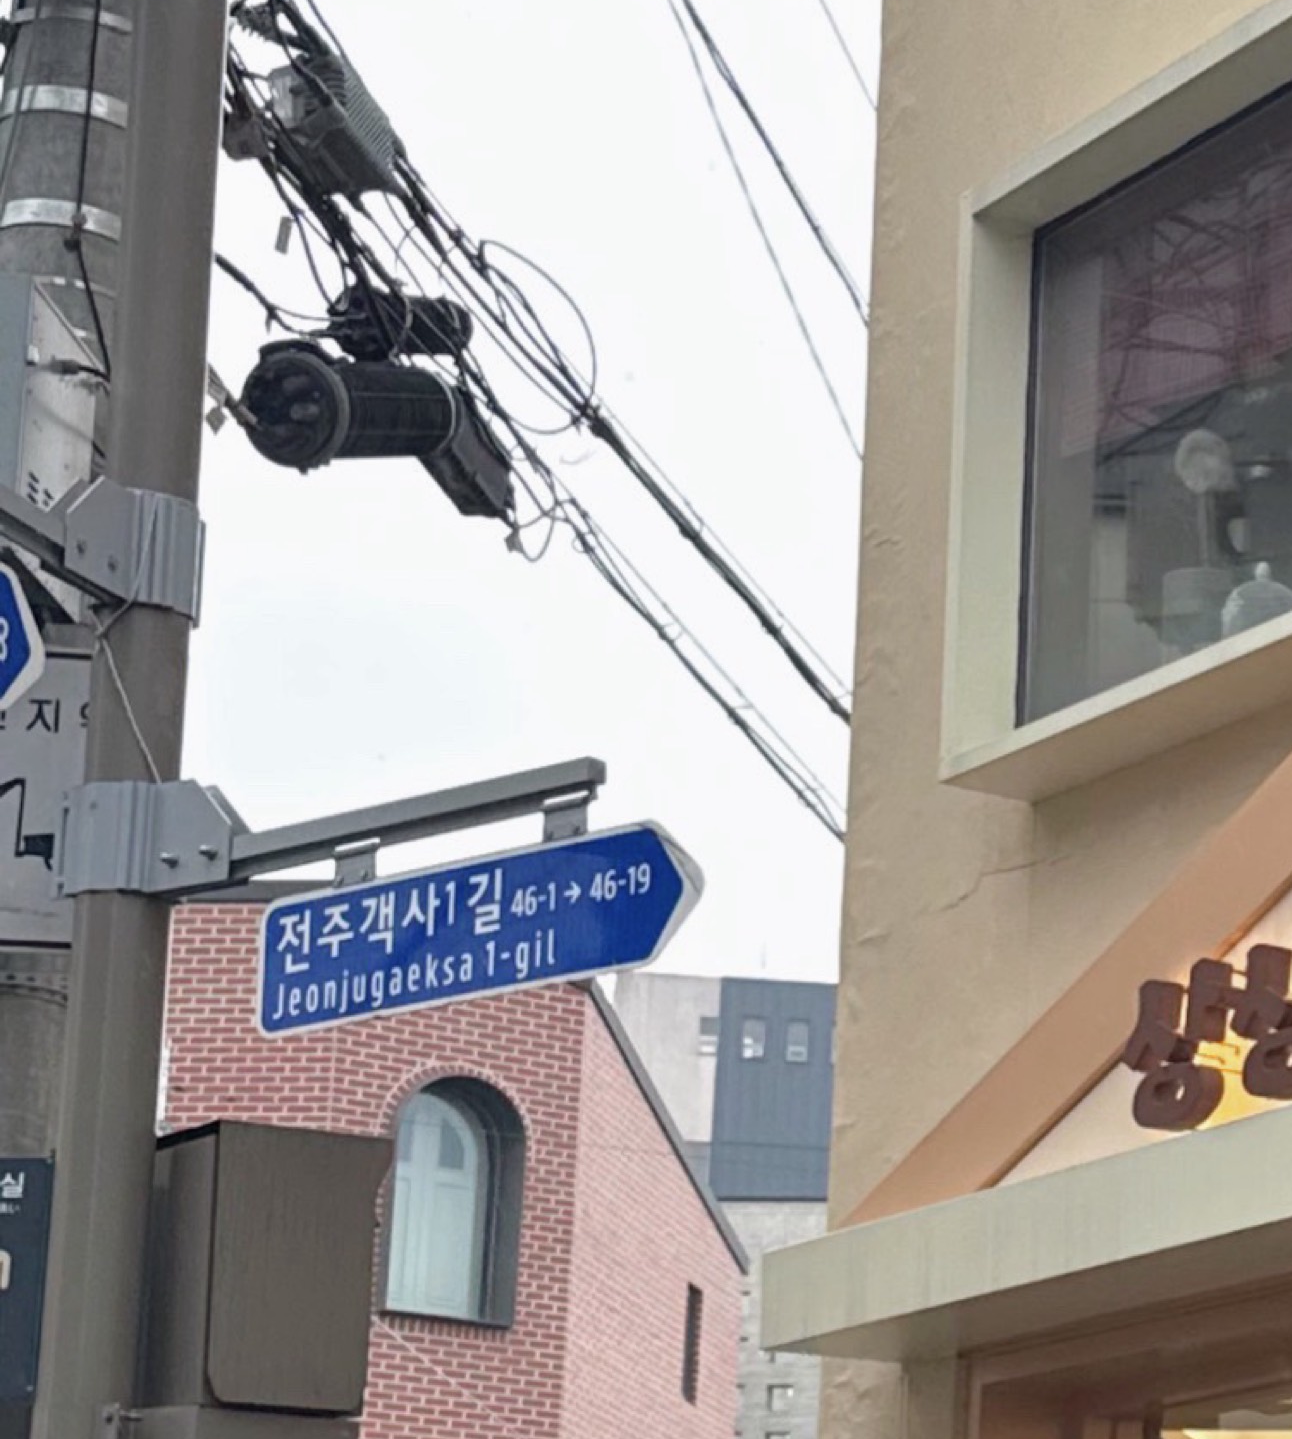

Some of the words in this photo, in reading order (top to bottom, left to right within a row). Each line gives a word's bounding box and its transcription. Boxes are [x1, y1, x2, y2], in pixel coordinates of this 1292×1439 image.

[276, 867, 503, 974] 전주객사1길
[511, 881, 556, 918] 46-1
[589, 863, 651, 903] 46-19
[272, 952, 474, 1020] Jeonjugaeksa
[485, 928, 556, 981] 1-gil
